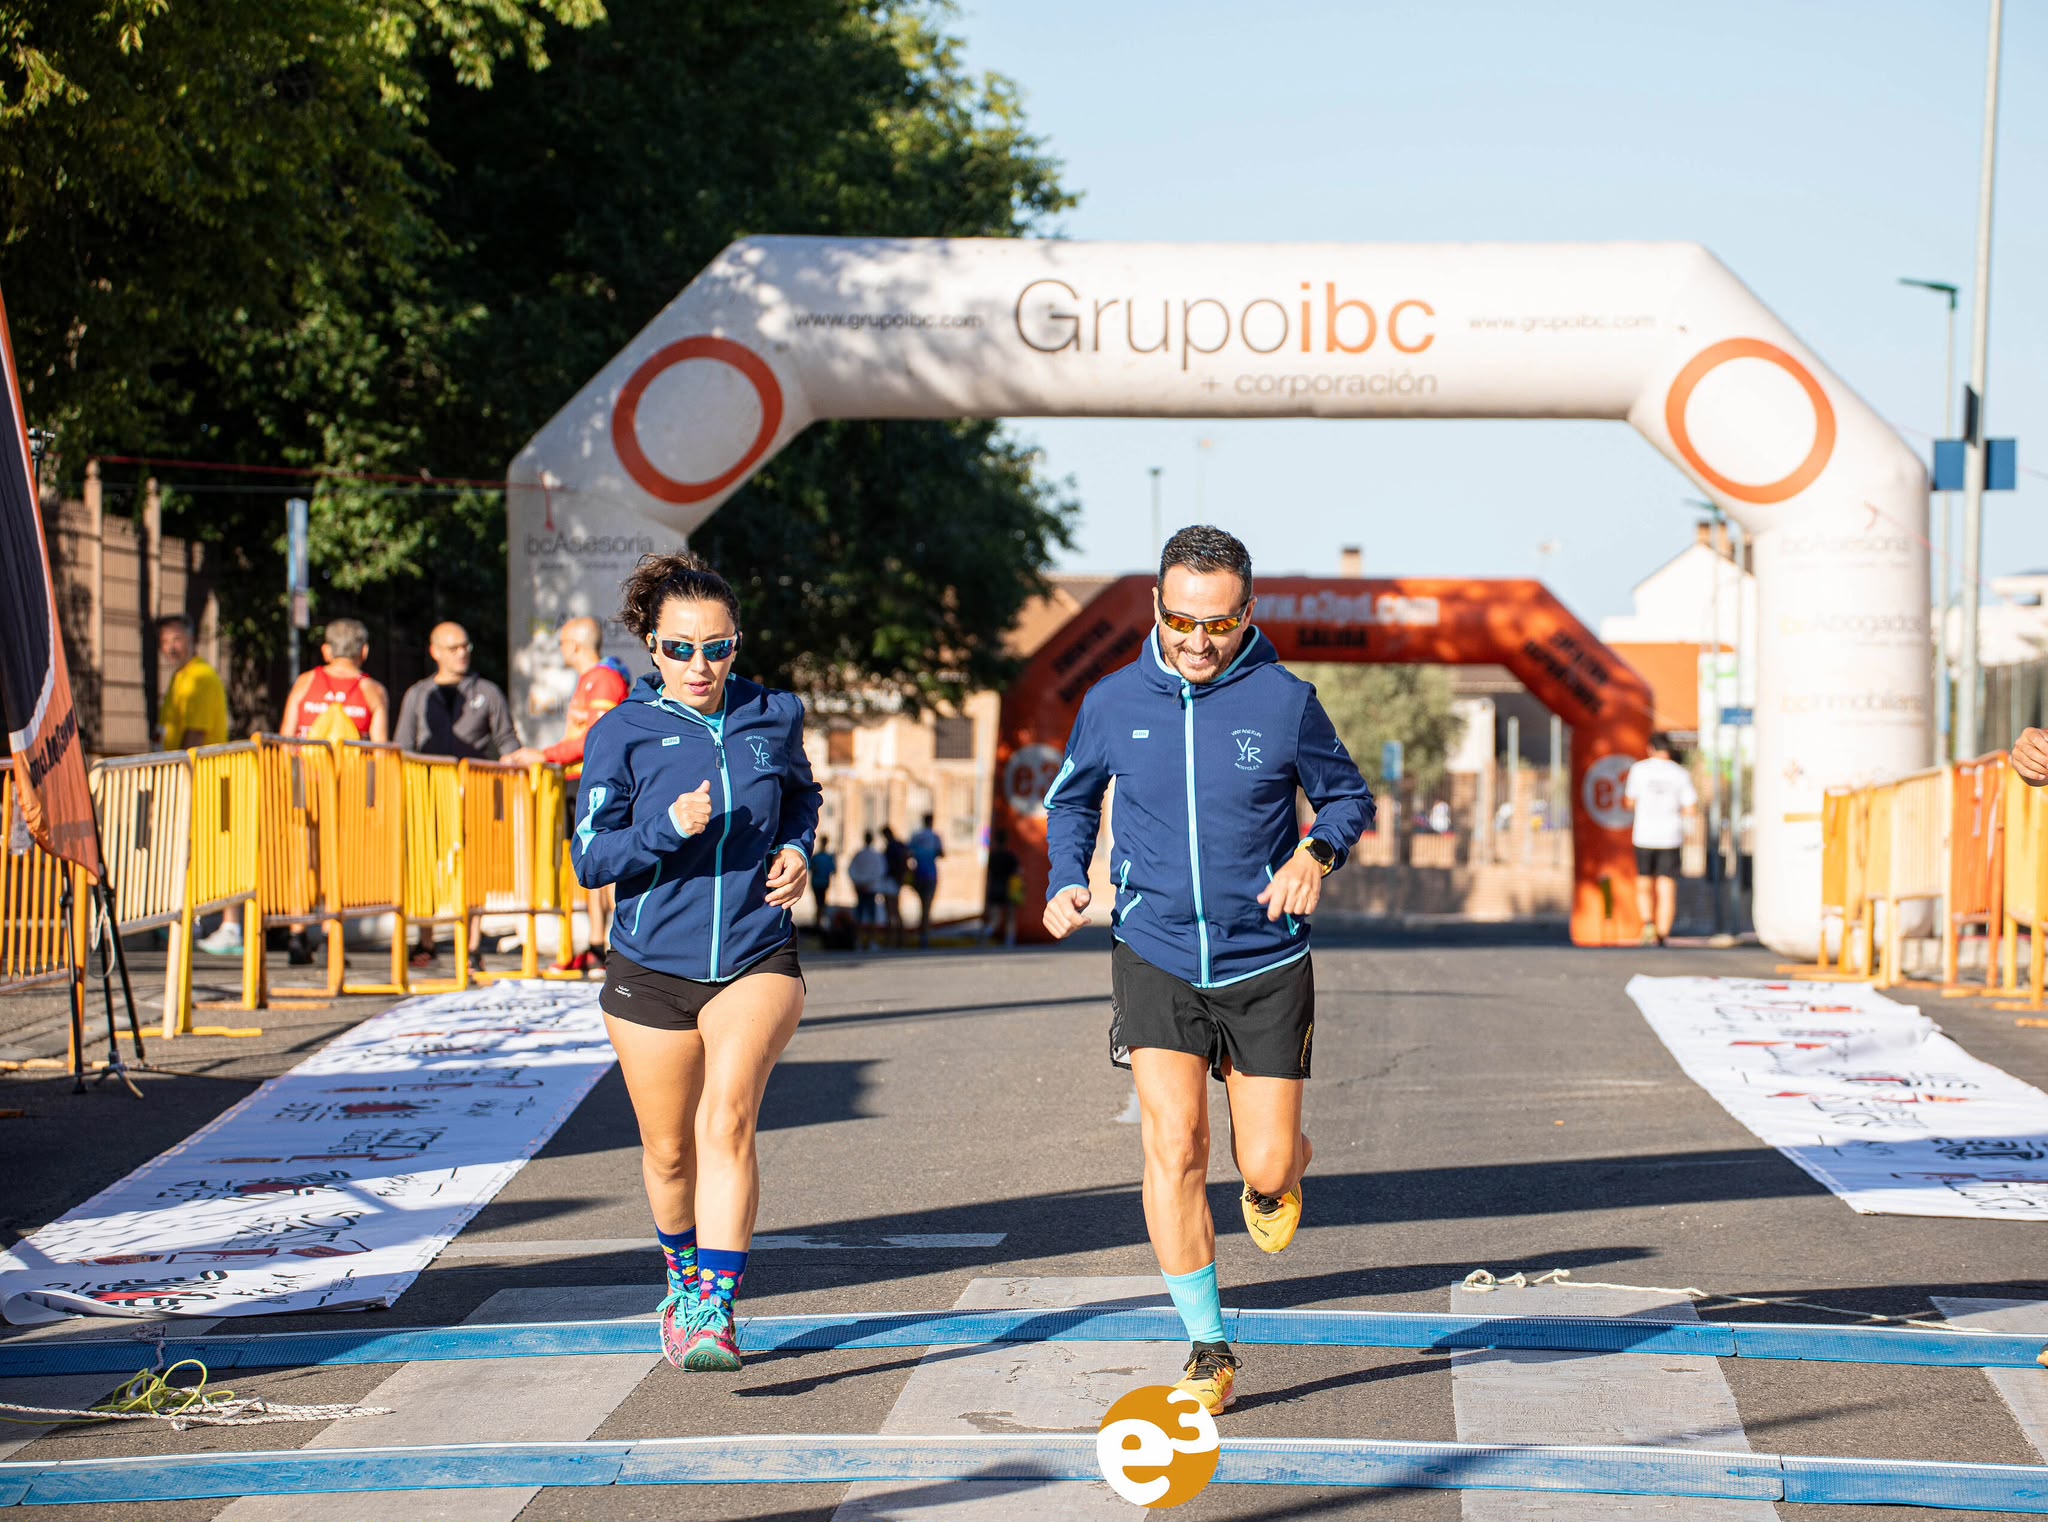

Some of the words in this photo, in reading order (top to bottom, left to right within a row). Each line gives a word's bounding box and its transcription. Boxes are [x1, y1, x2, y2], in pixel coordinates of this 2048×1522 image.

[794, 312, 984, 330] www.grupoibc.com
[1015, 278, 1437, 371] Grupoibc
[1467, 313, 1657, 332] www.grupoibc.com
[1235, 368, 1439, 397] corporación
